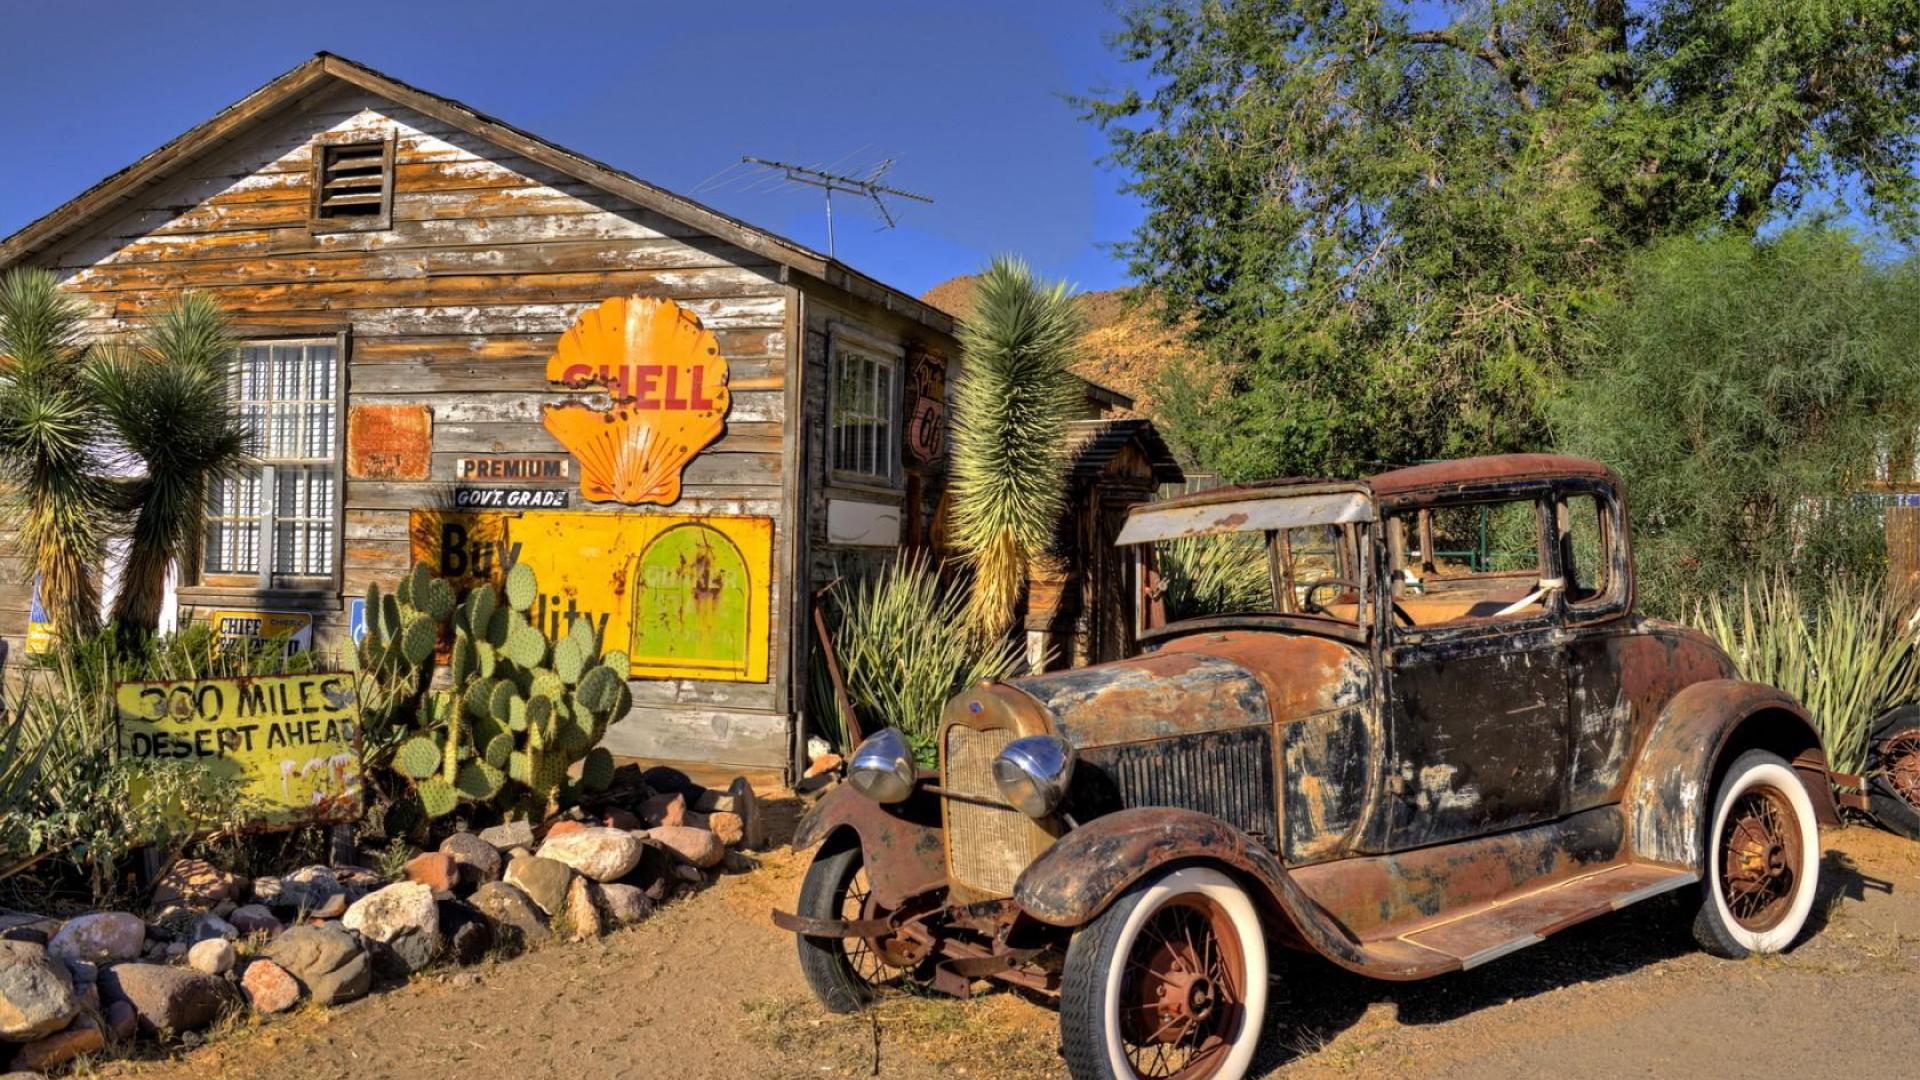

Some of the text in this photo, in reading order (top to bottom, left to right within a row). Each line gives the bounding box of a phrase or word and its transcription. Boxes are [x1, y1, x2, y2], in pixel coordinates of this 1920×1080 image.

[463, 459, 561, 478] PREMIUM
[506, 490, 567, 507] GRADE
[237, 678, 345, 719] MILES
[131, 724, 260, 759] DESERT
